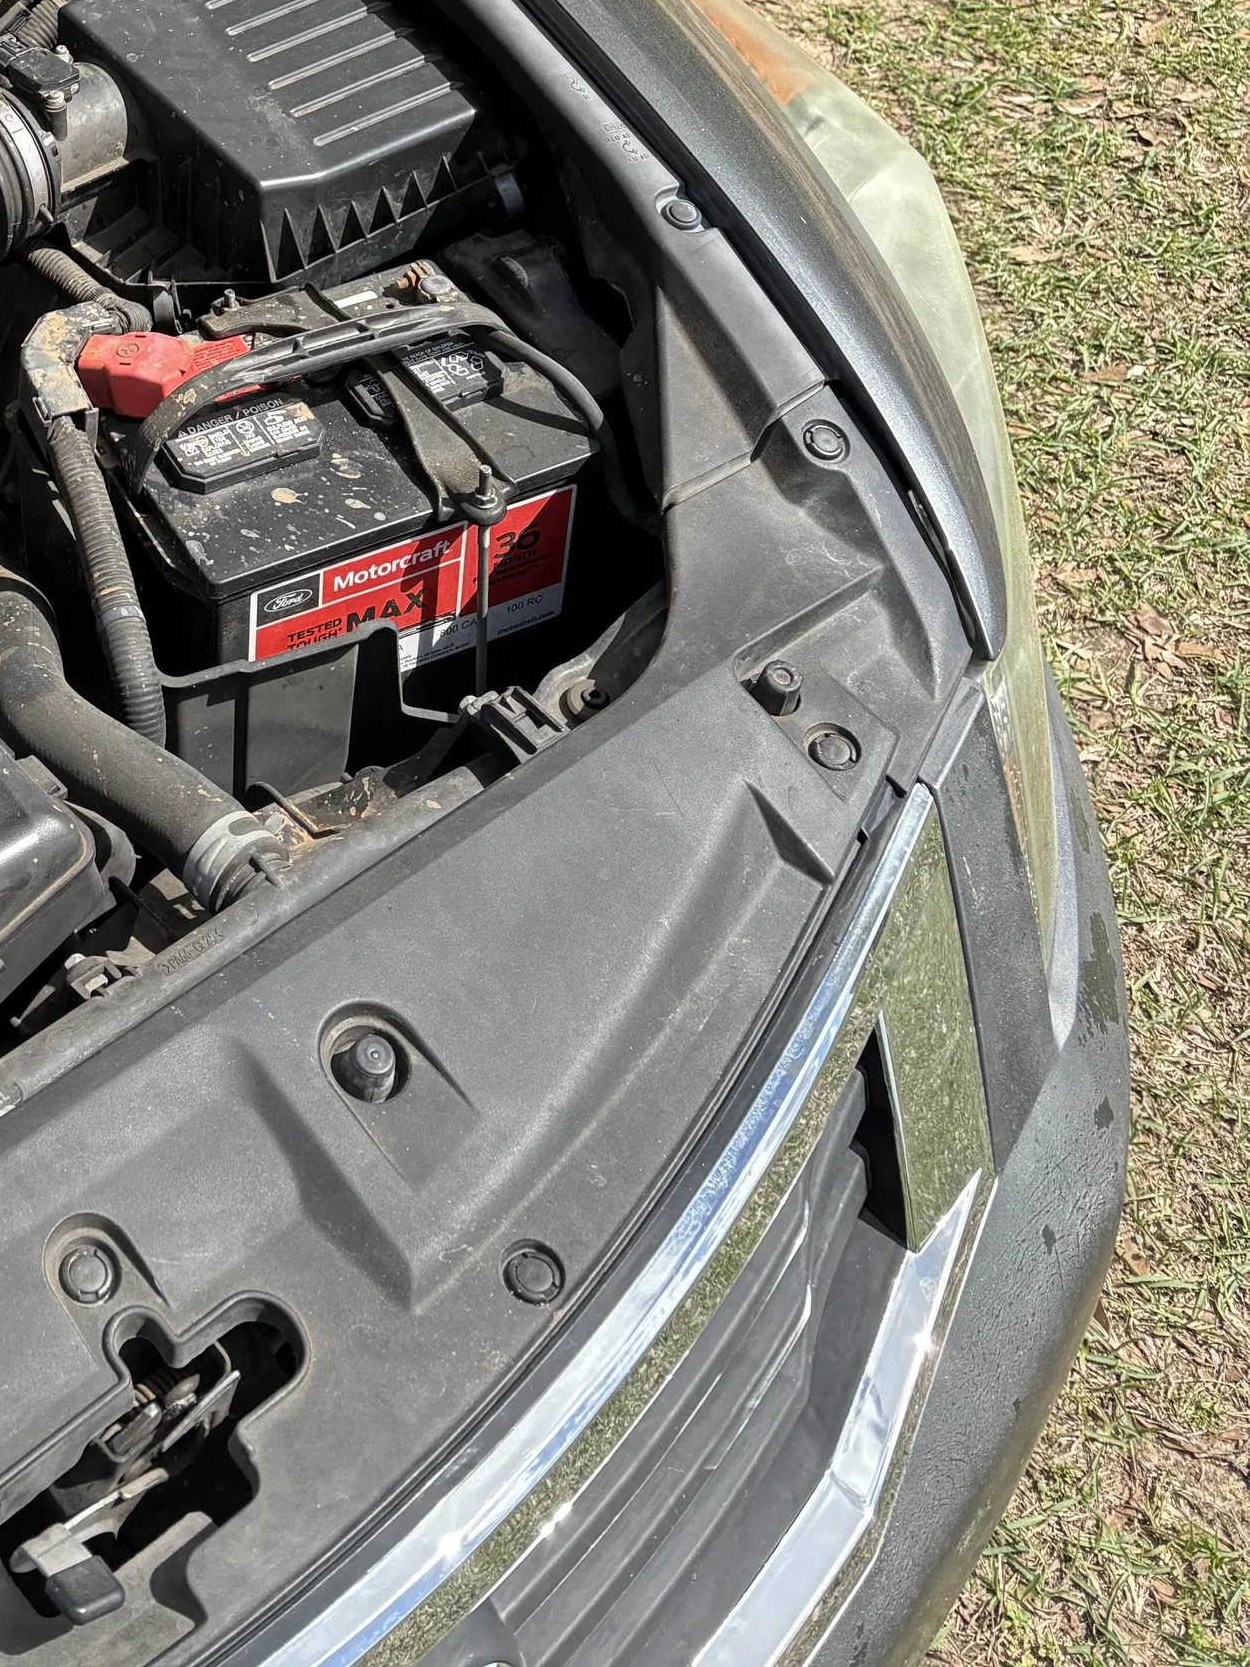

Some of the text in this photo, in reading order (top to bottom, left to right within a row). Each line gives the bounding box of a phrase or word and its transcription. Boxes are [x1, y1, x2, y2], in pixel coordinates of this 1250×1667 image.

[185, 416, 233, 434] DANGER
[243, 398, 285, 417] POISON
[493, 523, 542, 559] 36
[333, 538, 452, 592] Motorcraft
[272, 593, 305, 611] Ford
[345, 587, 427, 633] MAX
[506, 594, 544, 614] 100 RC
[288, 618, 342, 643] TESTED
